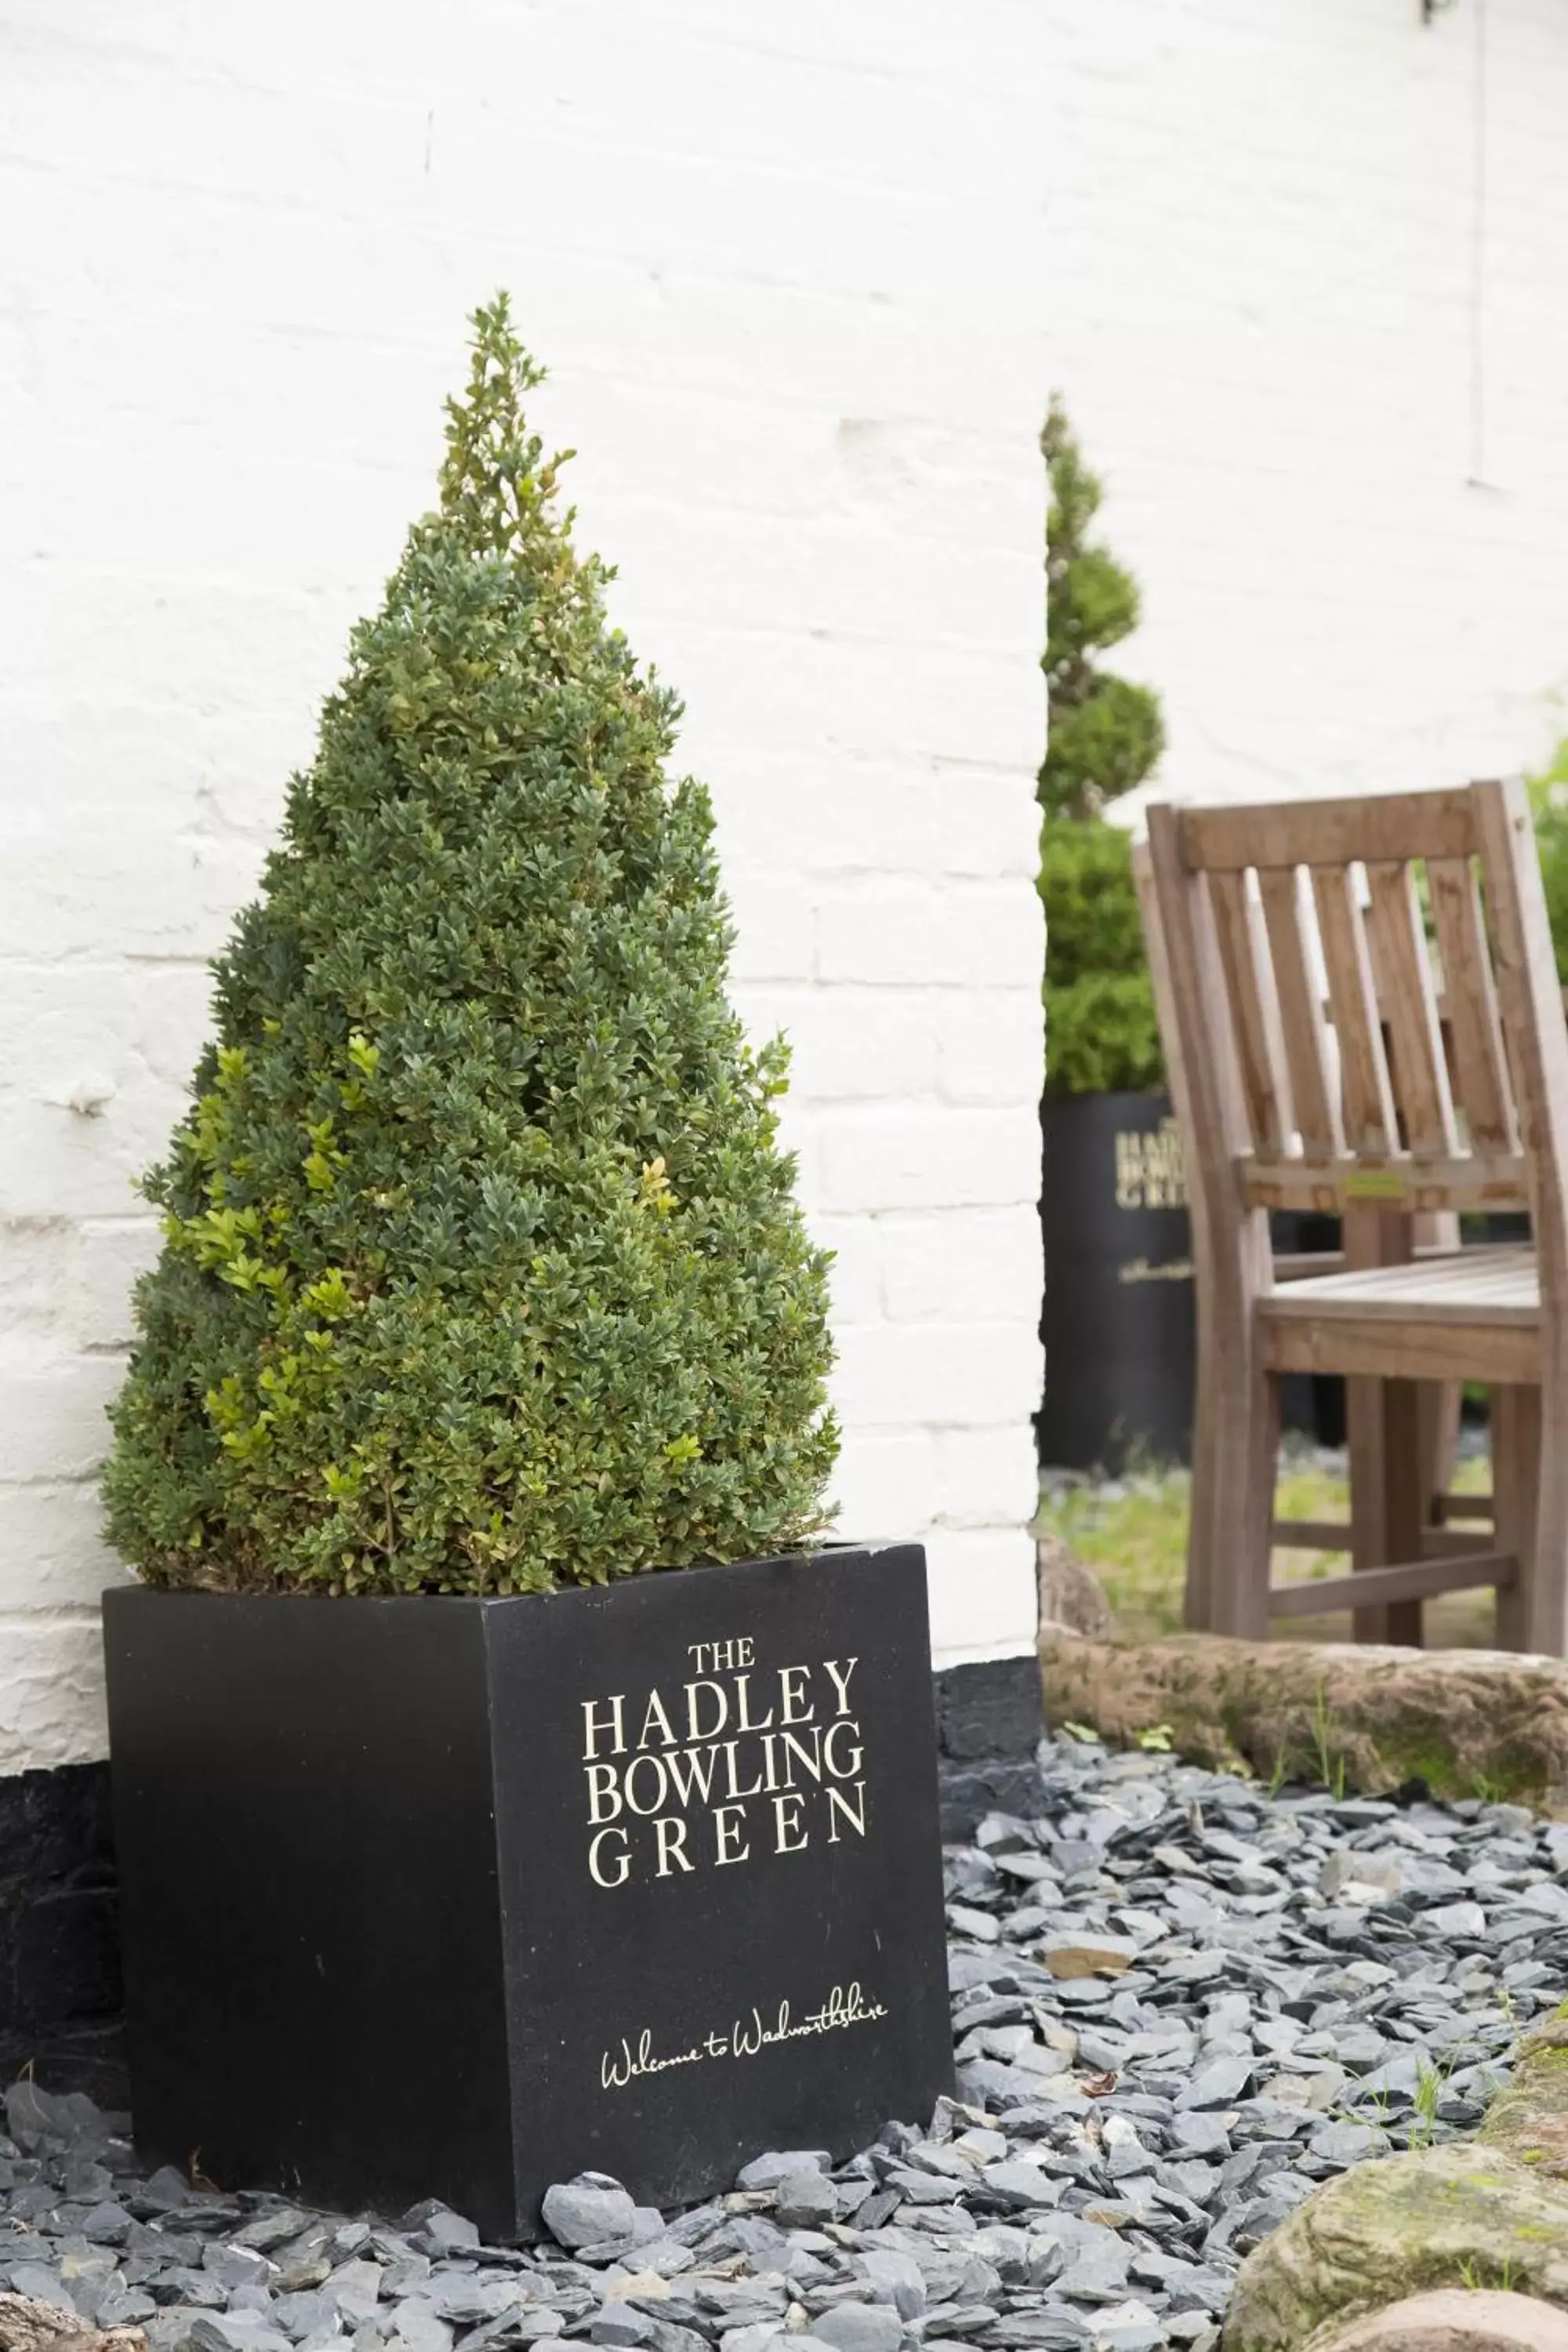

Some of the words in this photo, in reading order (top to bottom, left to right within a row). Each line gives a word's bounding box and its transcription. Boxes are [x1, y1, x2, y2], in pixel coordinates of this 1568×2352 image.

[688, 1636, 755, 1674] THE
[581, 1657, 858, 1760] HADLEY
[583, 1721, 865, 1824] BOWLING
[589, 1780, 866, 1888] GREEN
[601, 2029, 703, 2089] Welcome
[703, 2033, 729, 2056] to
[733, 1982, 888, 2057] Wadworthshire
